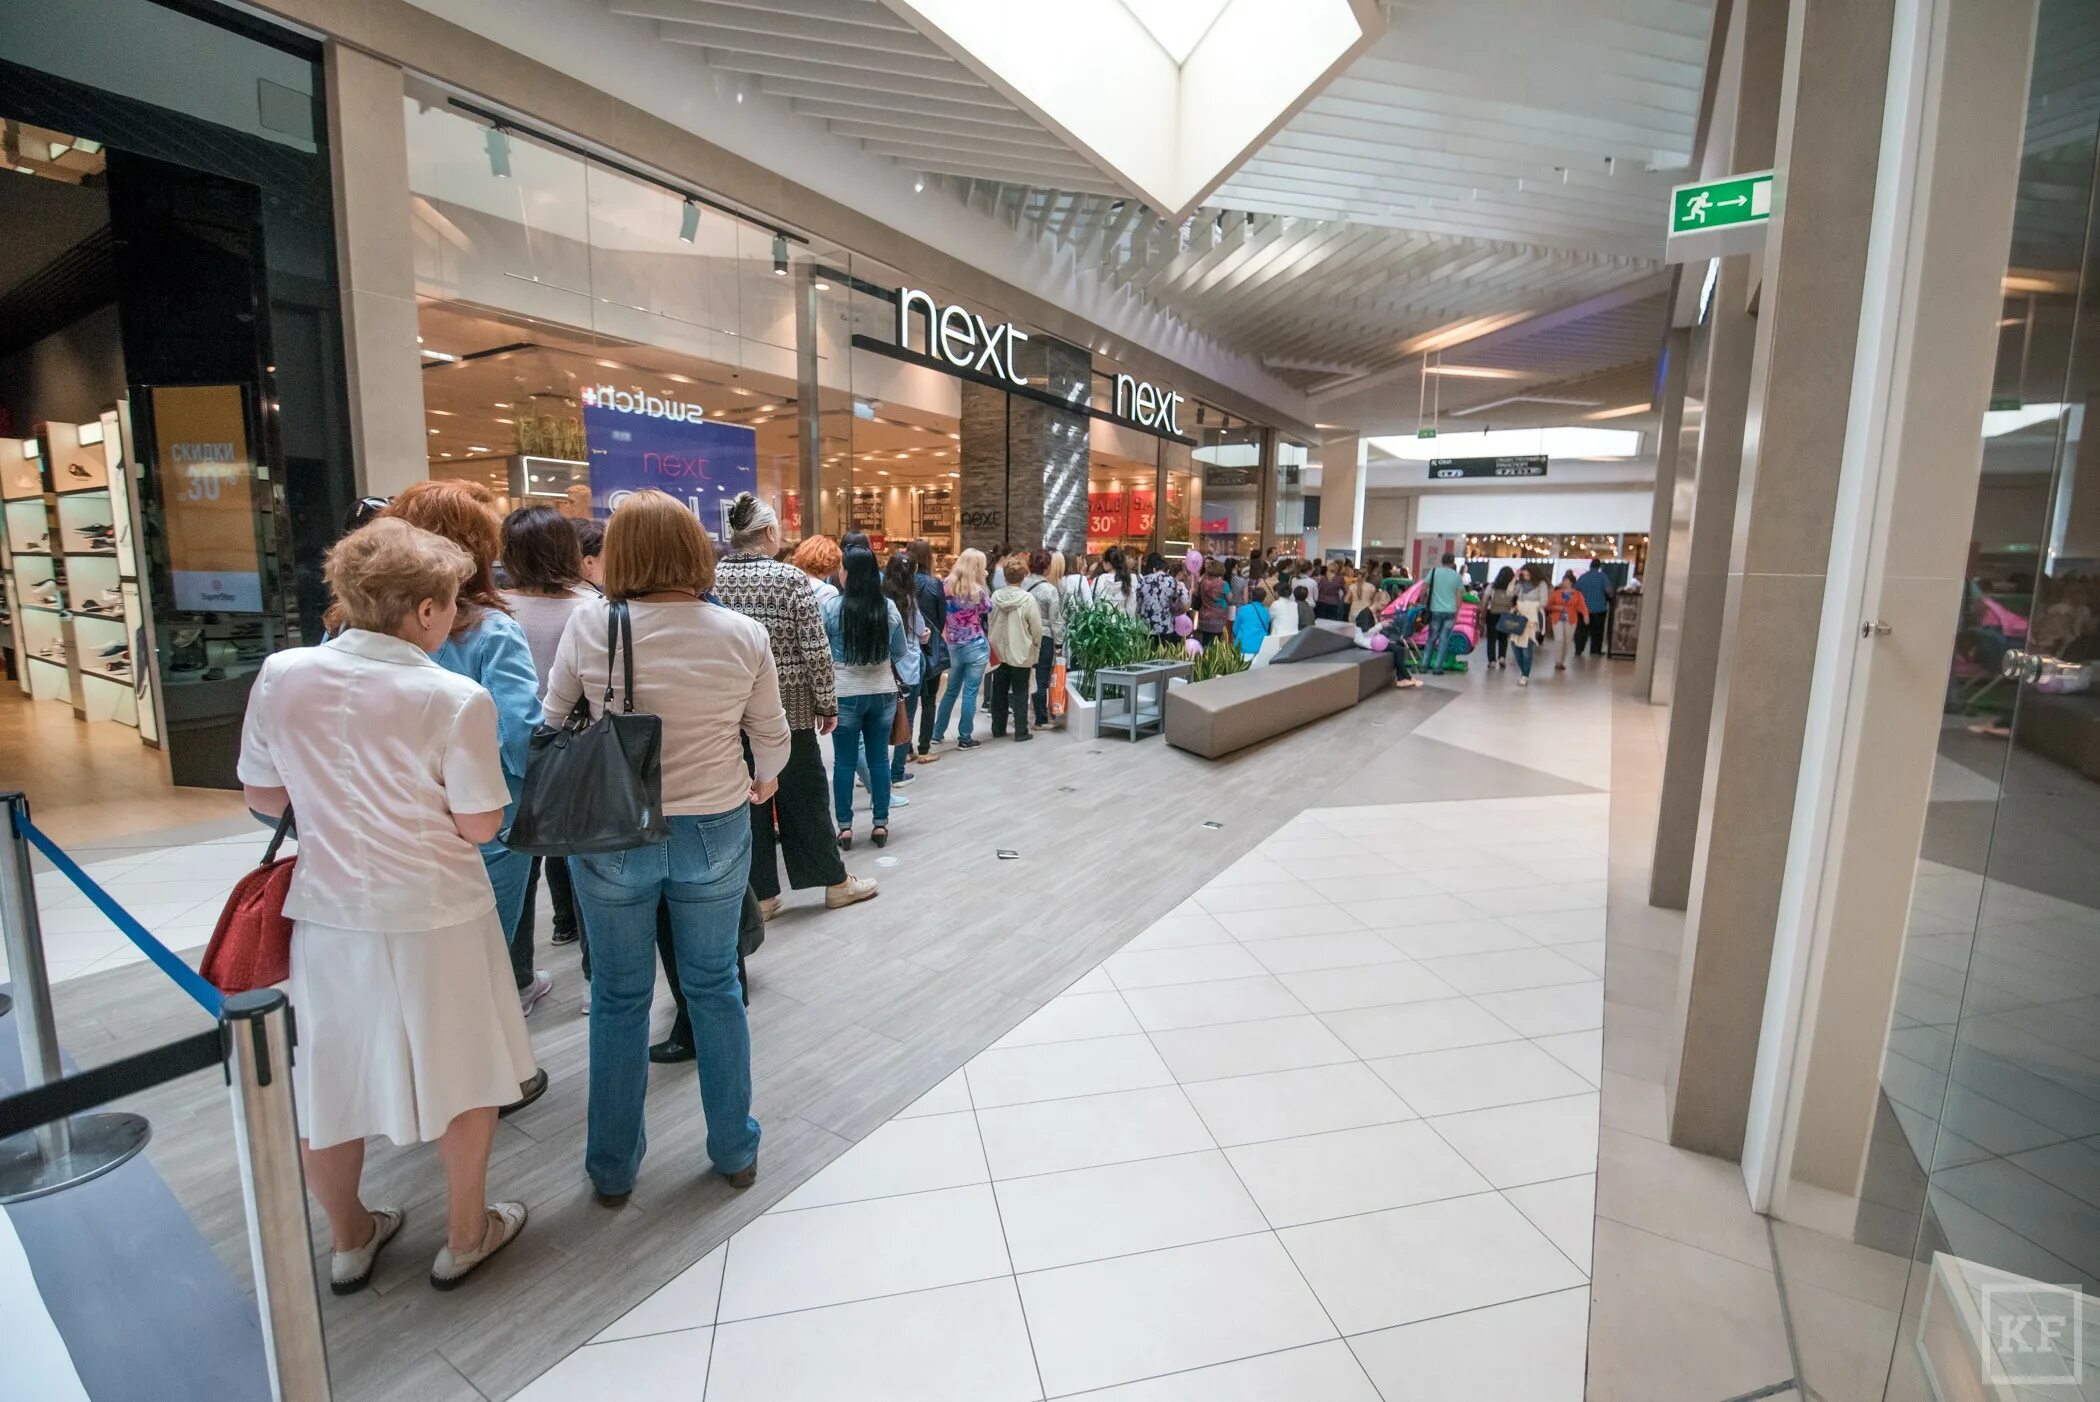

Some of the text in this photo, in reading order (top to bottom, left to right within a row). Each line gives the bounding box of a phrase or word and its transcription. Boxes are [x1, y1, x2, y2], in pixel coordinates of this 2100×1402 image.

[900, 286, 1029, 386] next
[1117, 373, 1185, 436] next
[642, 452, 712, 480] next
[960, 511, 1002, 527] next
